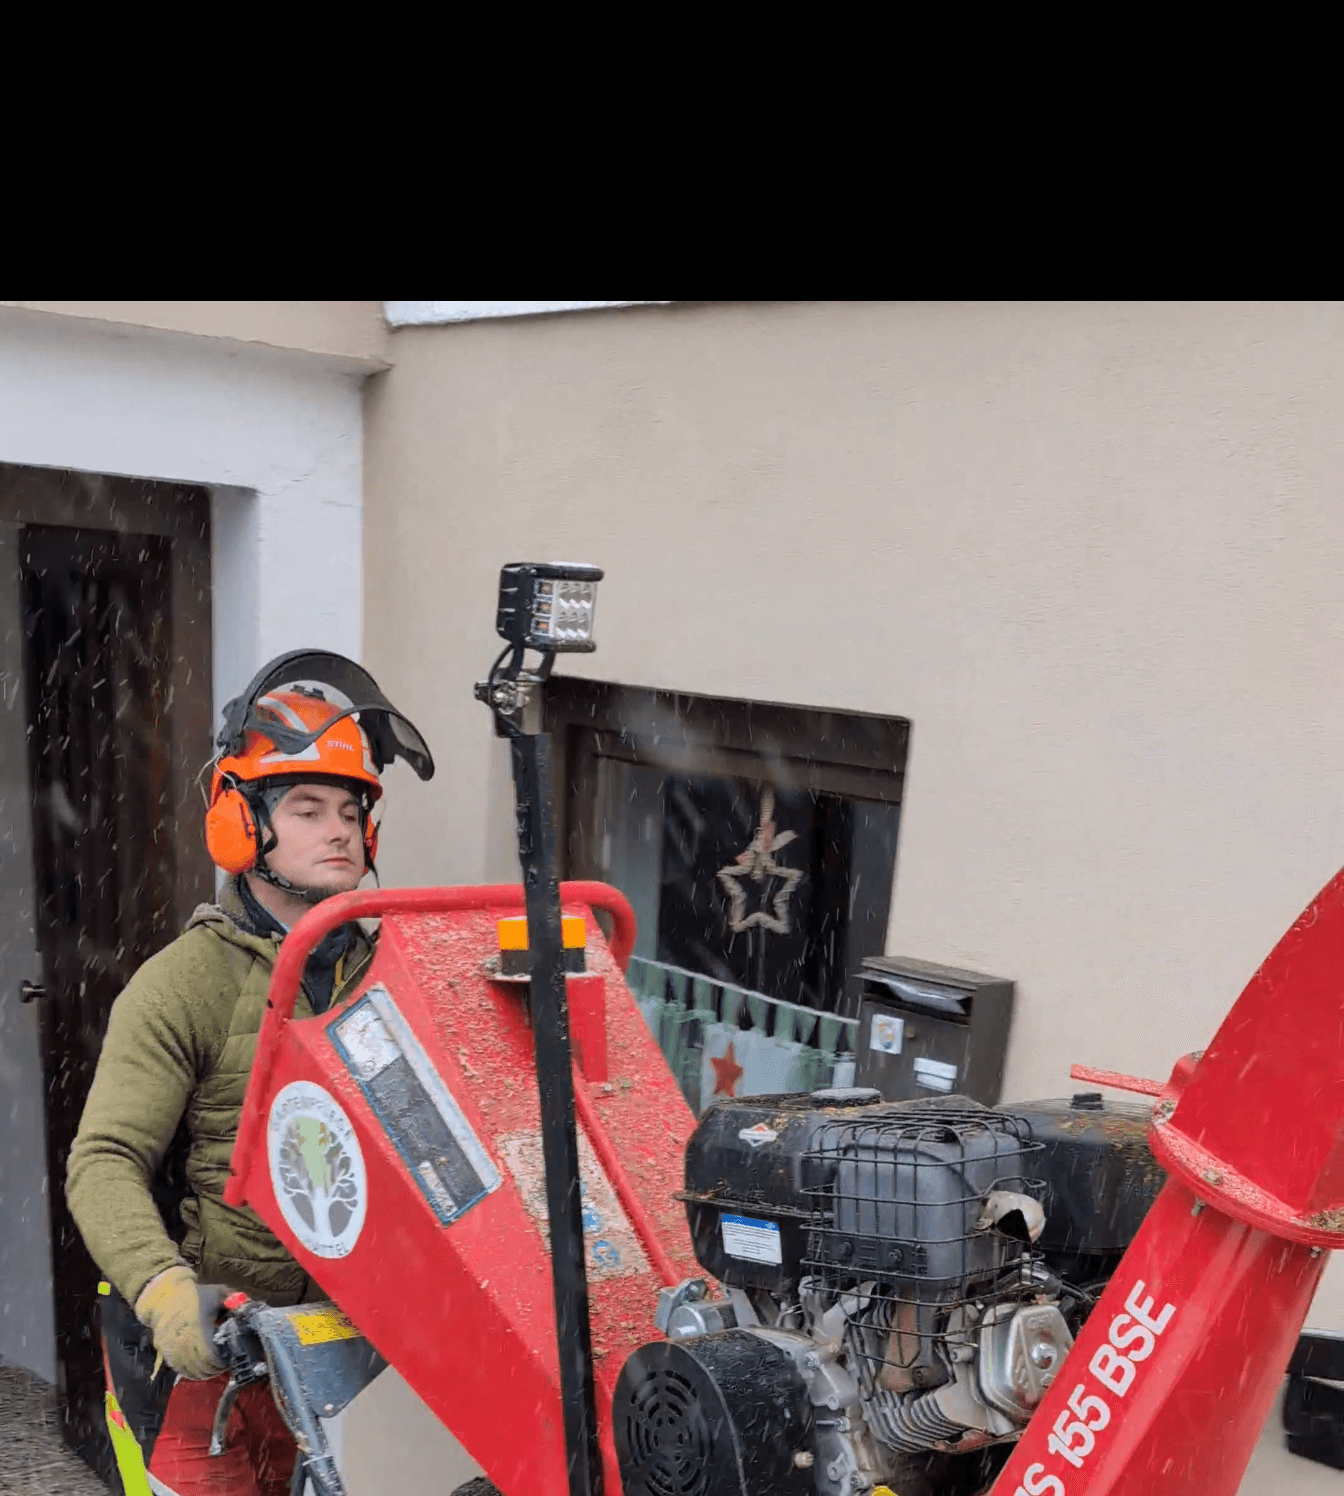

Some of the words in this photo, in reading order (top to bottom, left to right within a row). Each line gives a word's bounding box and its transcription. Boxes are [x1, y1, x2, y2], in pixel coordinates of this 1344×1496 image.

[326, 740, 354, 751] STIHL
[1048, 1385, 1111, 1468] 155
[1089, 1280, 1176, 1397] BSE
